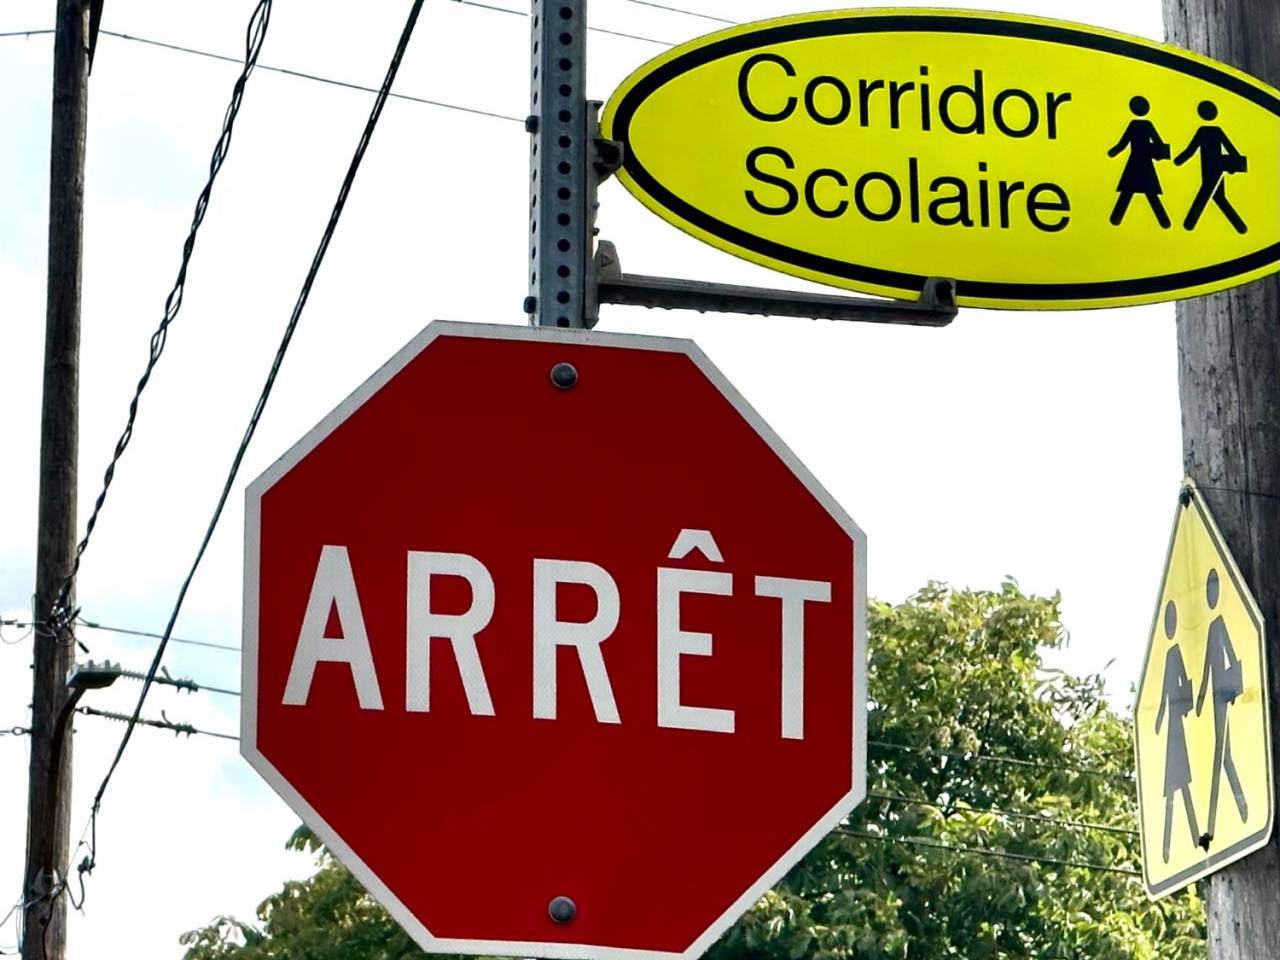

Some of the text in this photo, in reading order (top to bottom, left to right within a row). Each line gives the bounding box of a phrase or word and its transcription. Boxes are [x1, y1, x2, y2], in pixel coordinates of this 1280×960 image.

[737, 52, 1072, 140] Corridor
[744, 145, 1071, 233] Scolaire
[281, 528, 832, 741] ARRÊT
